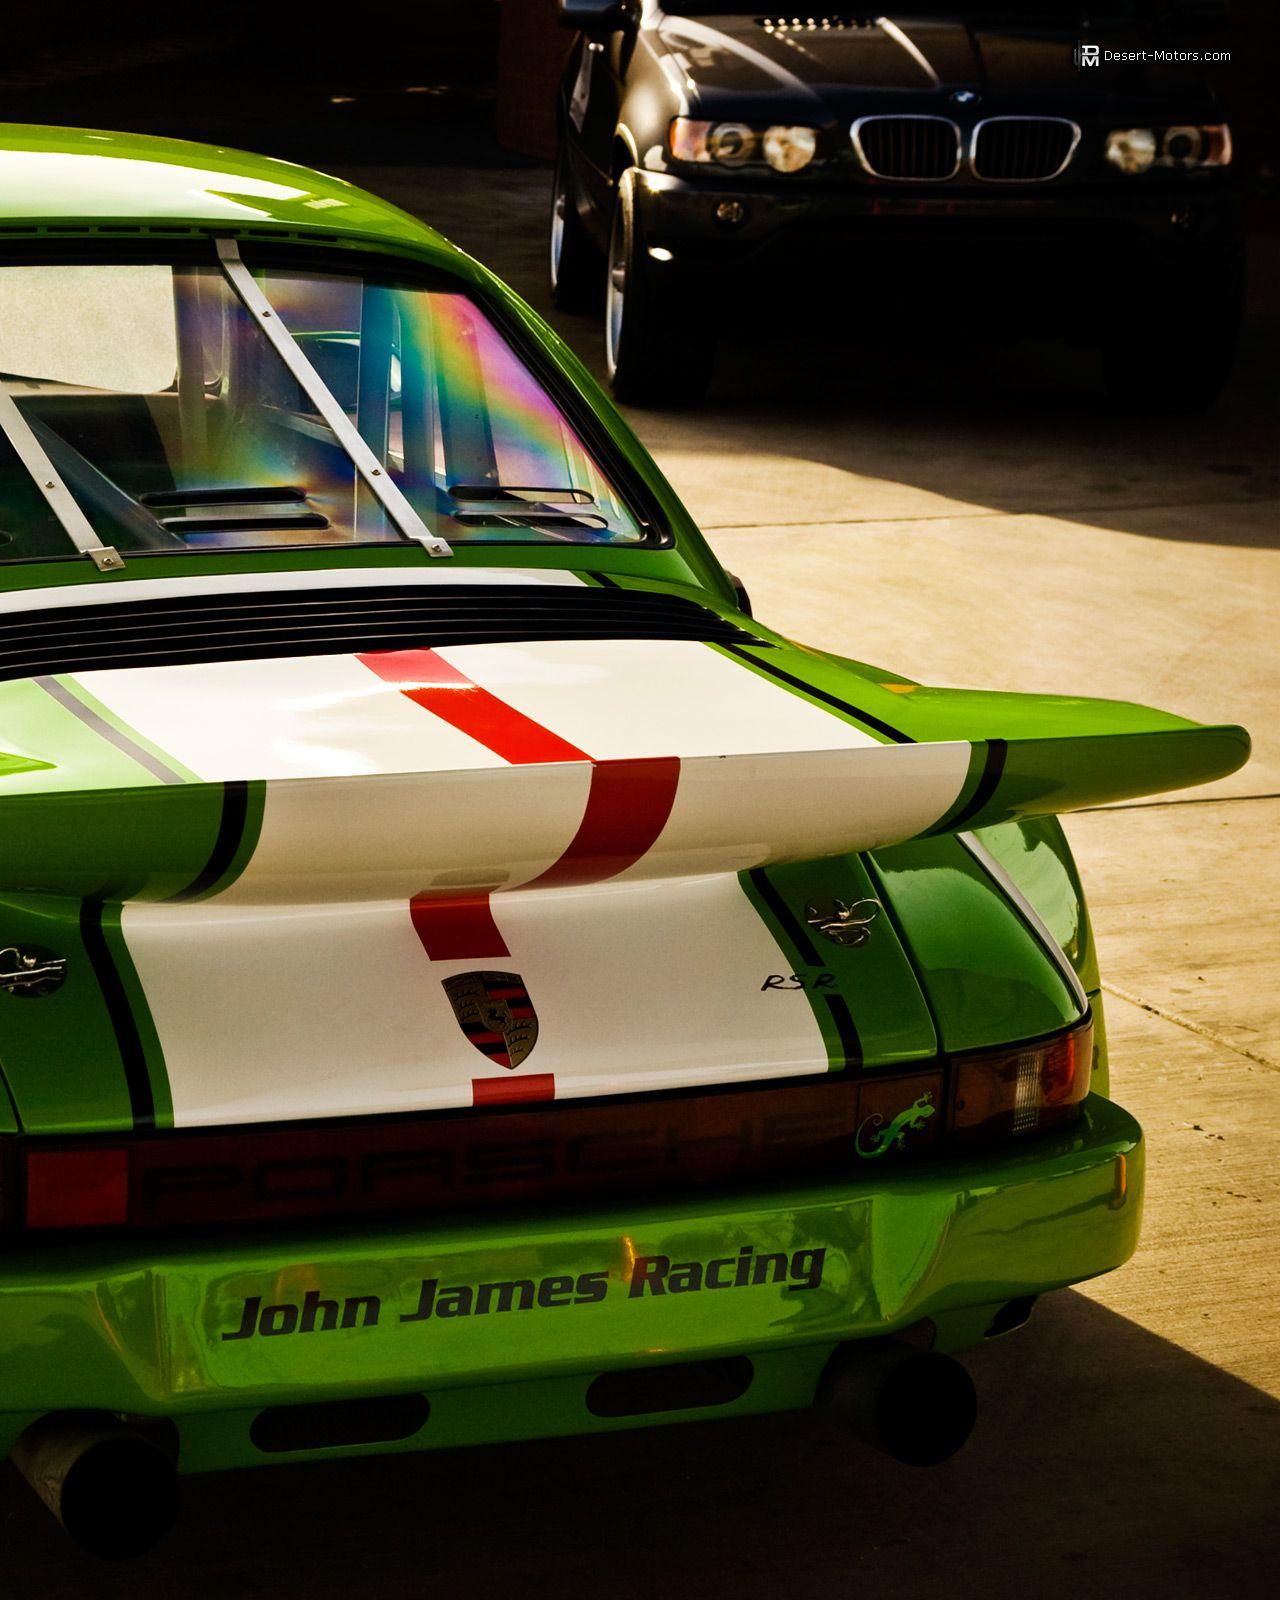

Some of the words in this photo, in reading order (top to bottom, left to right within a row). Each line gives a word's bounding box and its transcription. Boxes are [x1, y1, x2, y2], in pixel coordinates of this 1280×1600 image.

[141, 1111, 847, 1207] PORSCHE
[221, 1291, 380, 1341] John
[399, 1271, 609, 1323] James
[627, 1245, 827, 1299] Racing
